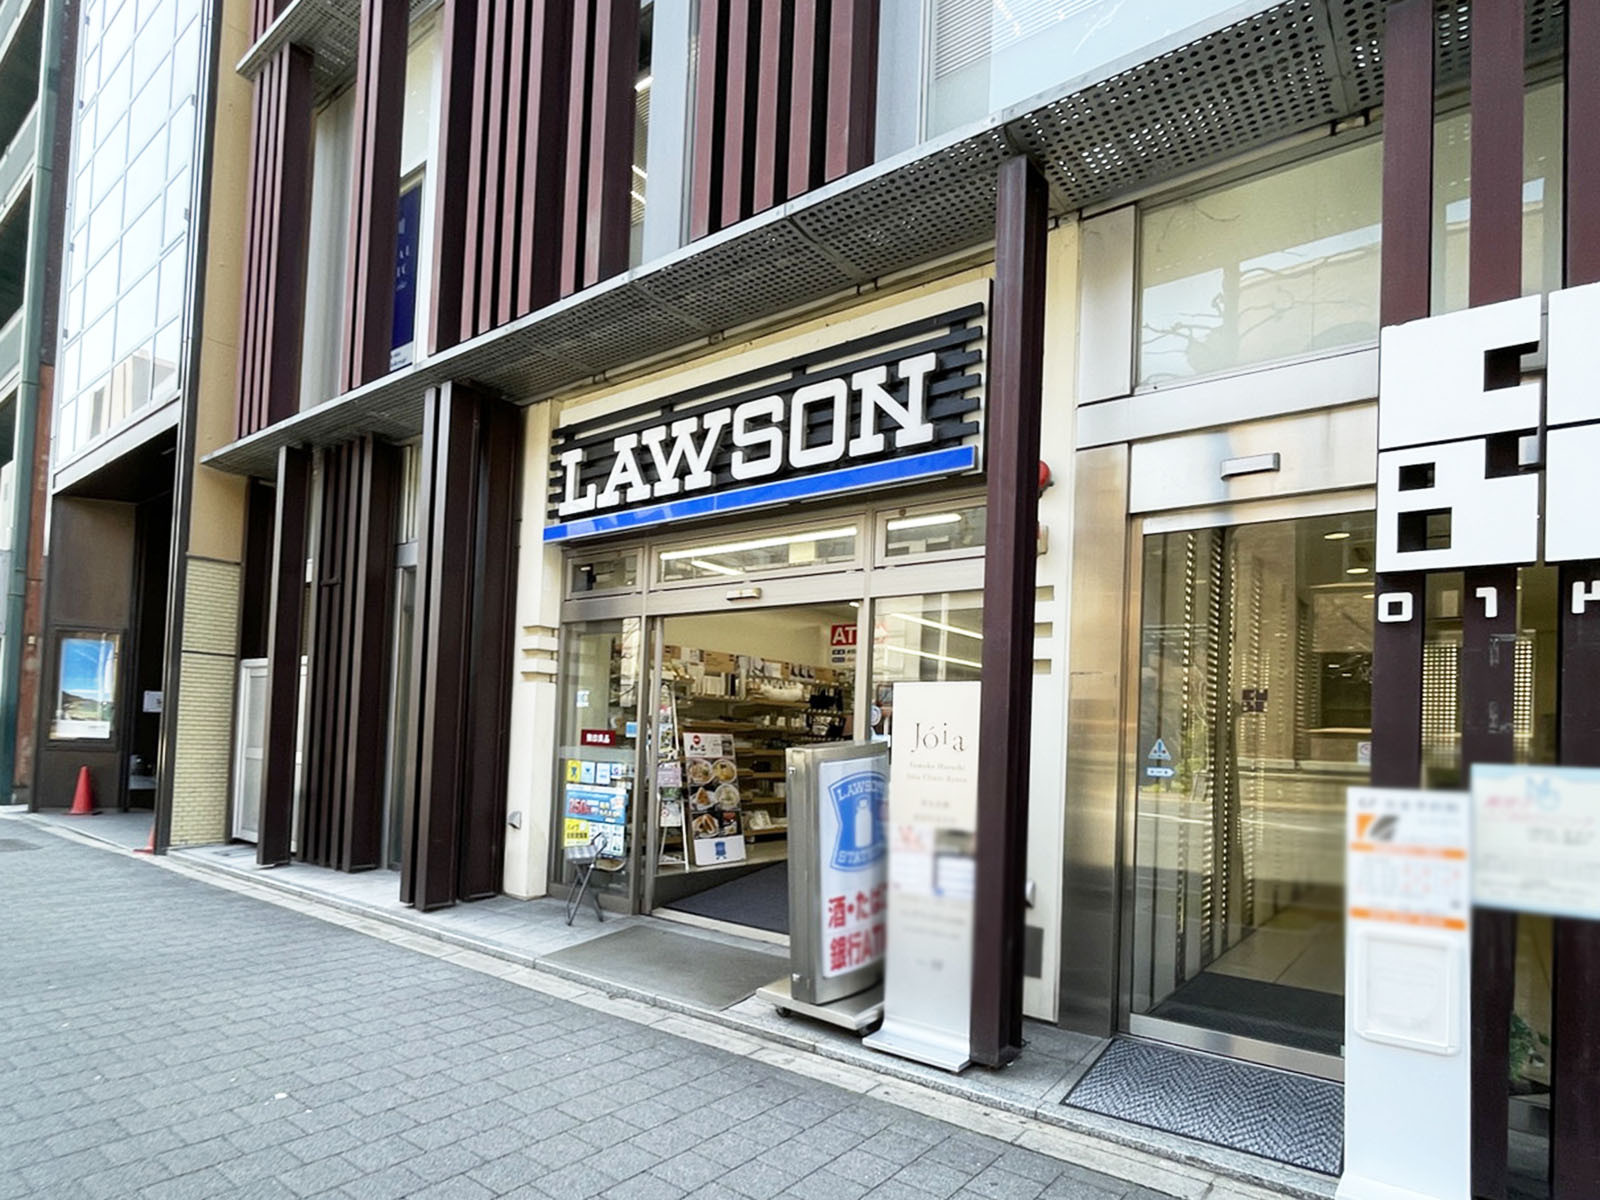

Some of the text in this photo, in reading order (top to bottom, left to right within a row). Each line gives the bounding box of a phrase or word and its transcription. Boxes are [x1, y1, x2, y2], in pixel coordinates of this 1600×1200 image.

[558, 352, 937, 517] LAWSON
[832, 627, 857, 644] AT
[911, 722, 964, 752] Jóia
